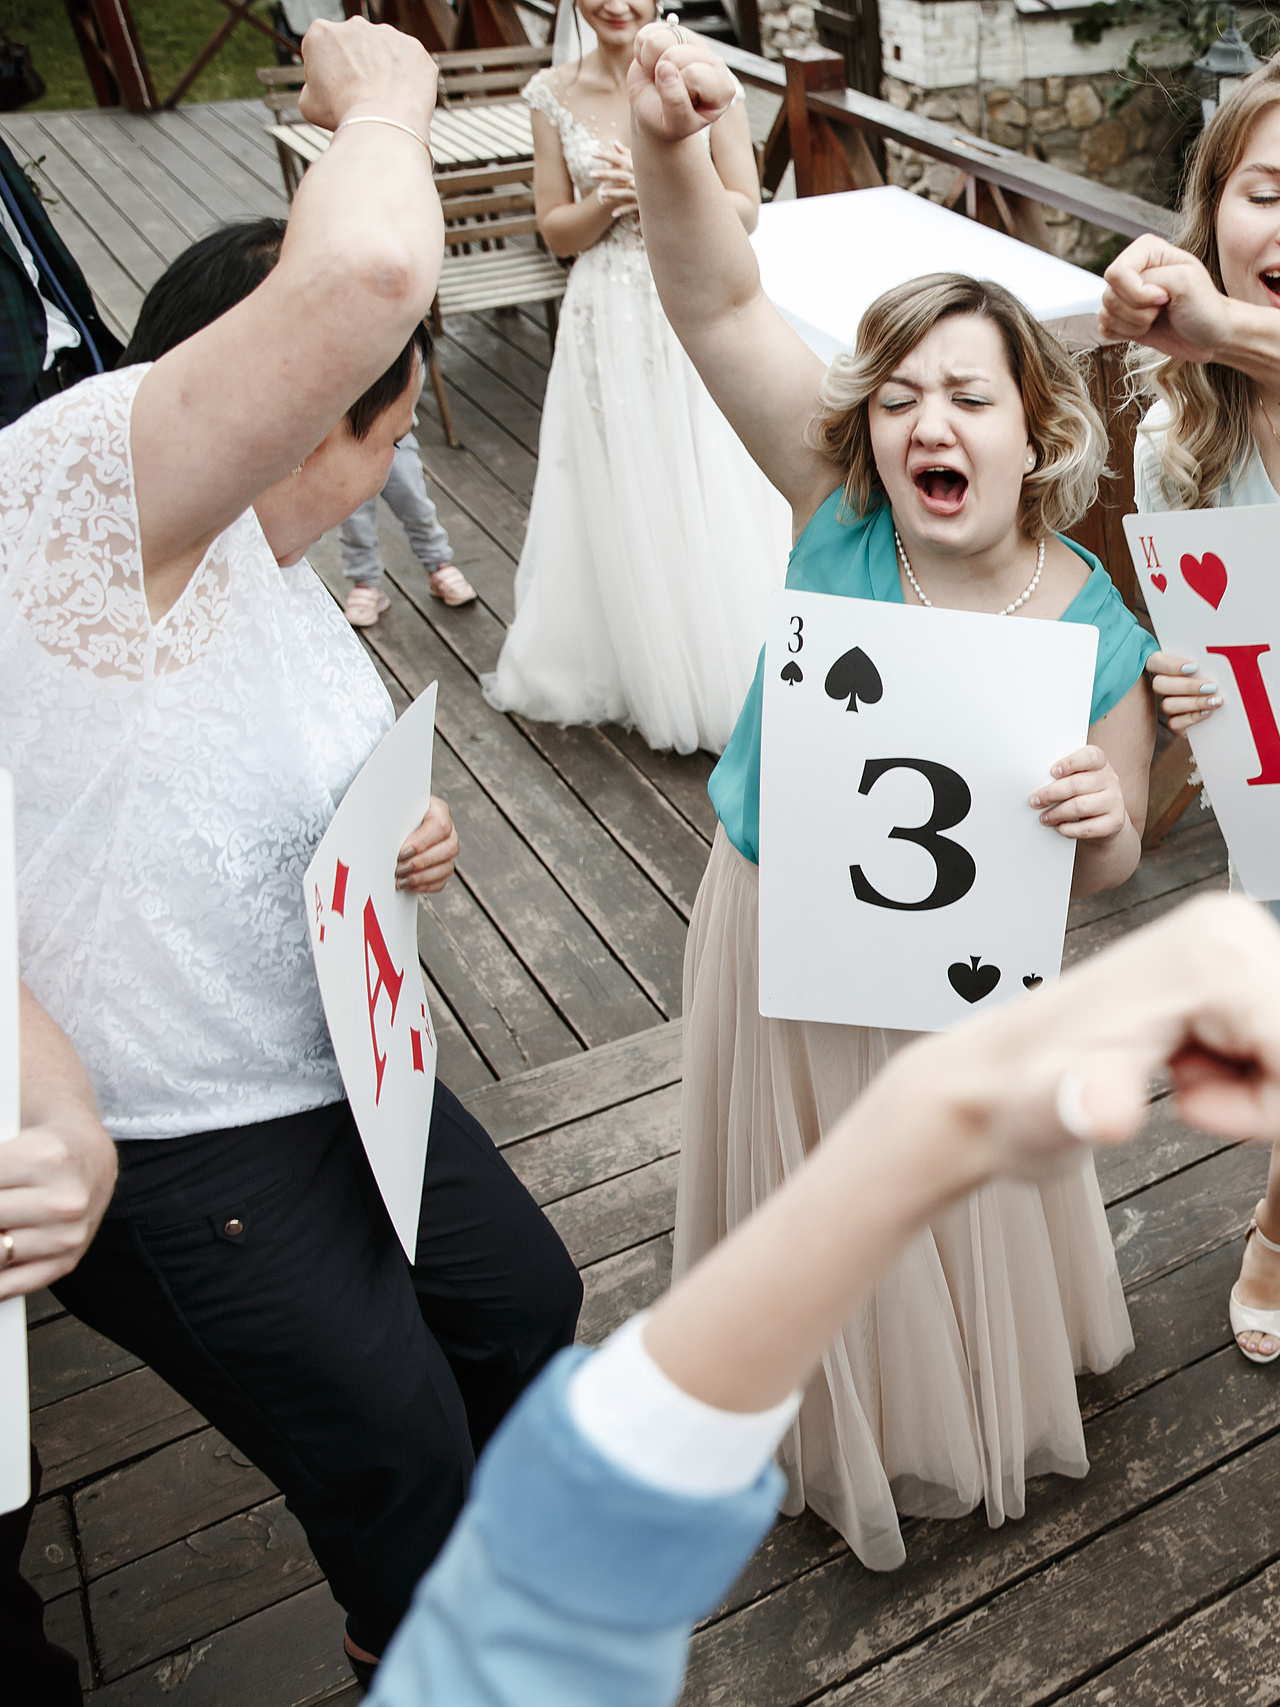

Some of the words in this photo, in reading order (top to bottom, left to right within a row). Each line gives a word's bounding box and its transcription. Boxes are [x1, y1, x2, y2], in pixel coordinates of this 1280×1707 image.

[1138, 536, 1162, 568] И
[849, 757, 977, 912] З
[363, 894, 404, 1107] А
